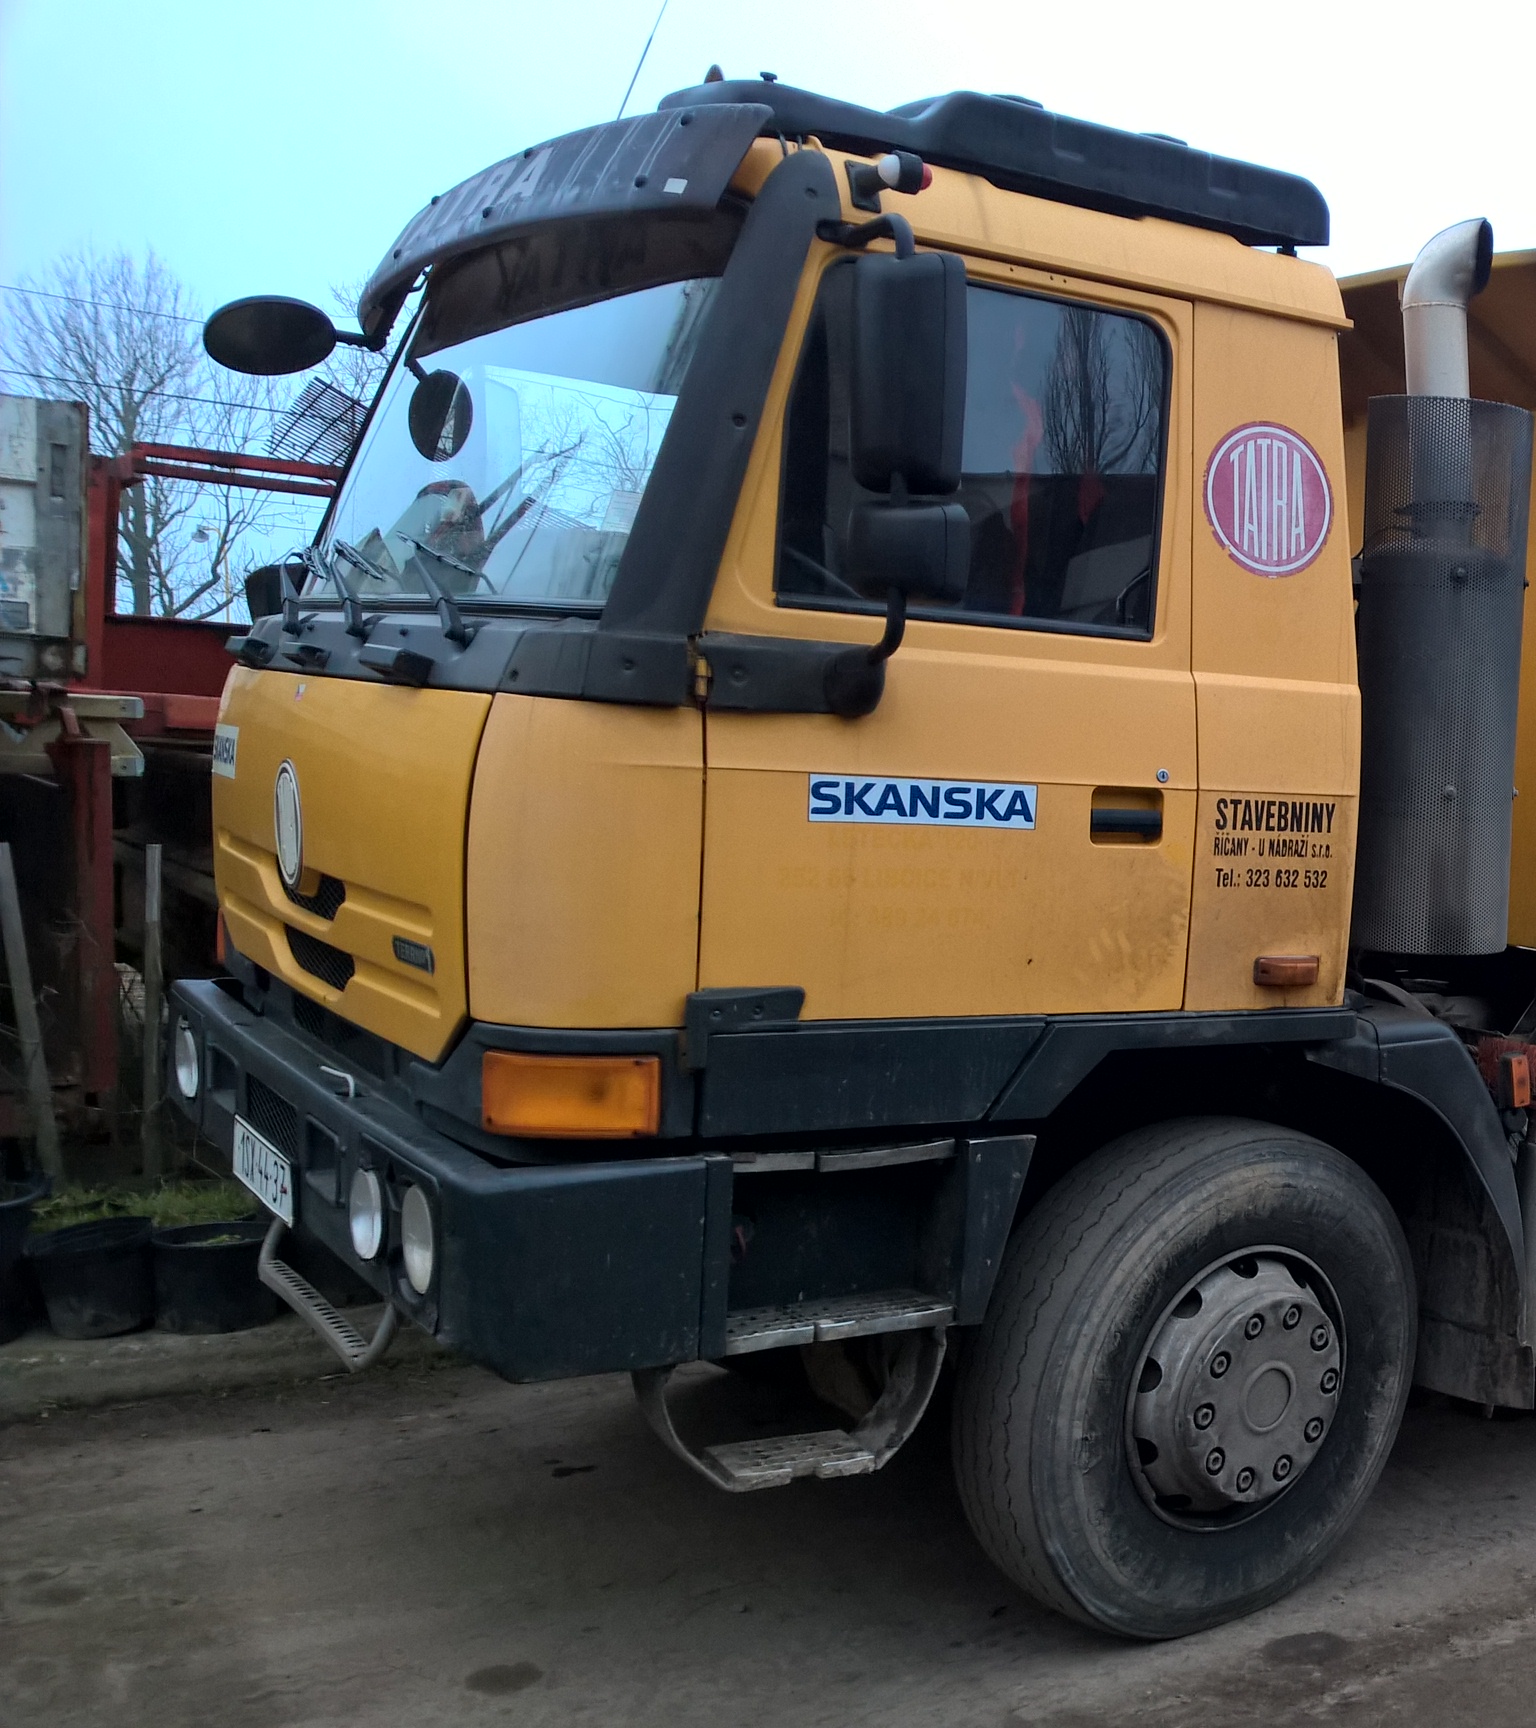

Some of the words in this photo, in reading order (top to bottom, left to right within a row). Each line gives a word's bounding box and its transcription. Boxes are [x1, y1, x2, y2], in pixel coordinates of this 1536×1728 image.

[1229, 438, 1306, 561] TATRA
[810, 780, 1034, 823] SKANSKA
[1215, 797, 1336, 834] STAVEBNINY
[1213, 832, 1249, 857] ŘÍČANY
[1258, 838, 1266, 857] U
[1268, 833, 1310, 858] NÁDRAŽÍ
[1311, 843, 1333, 859] s.r.o.
[1215, 868, 1241, 888] Tel.:
[1246, 868, 1270, 888] 323
[1275, 869, 1300, 888] 632
[1304, 870, 1328, 889] 532
